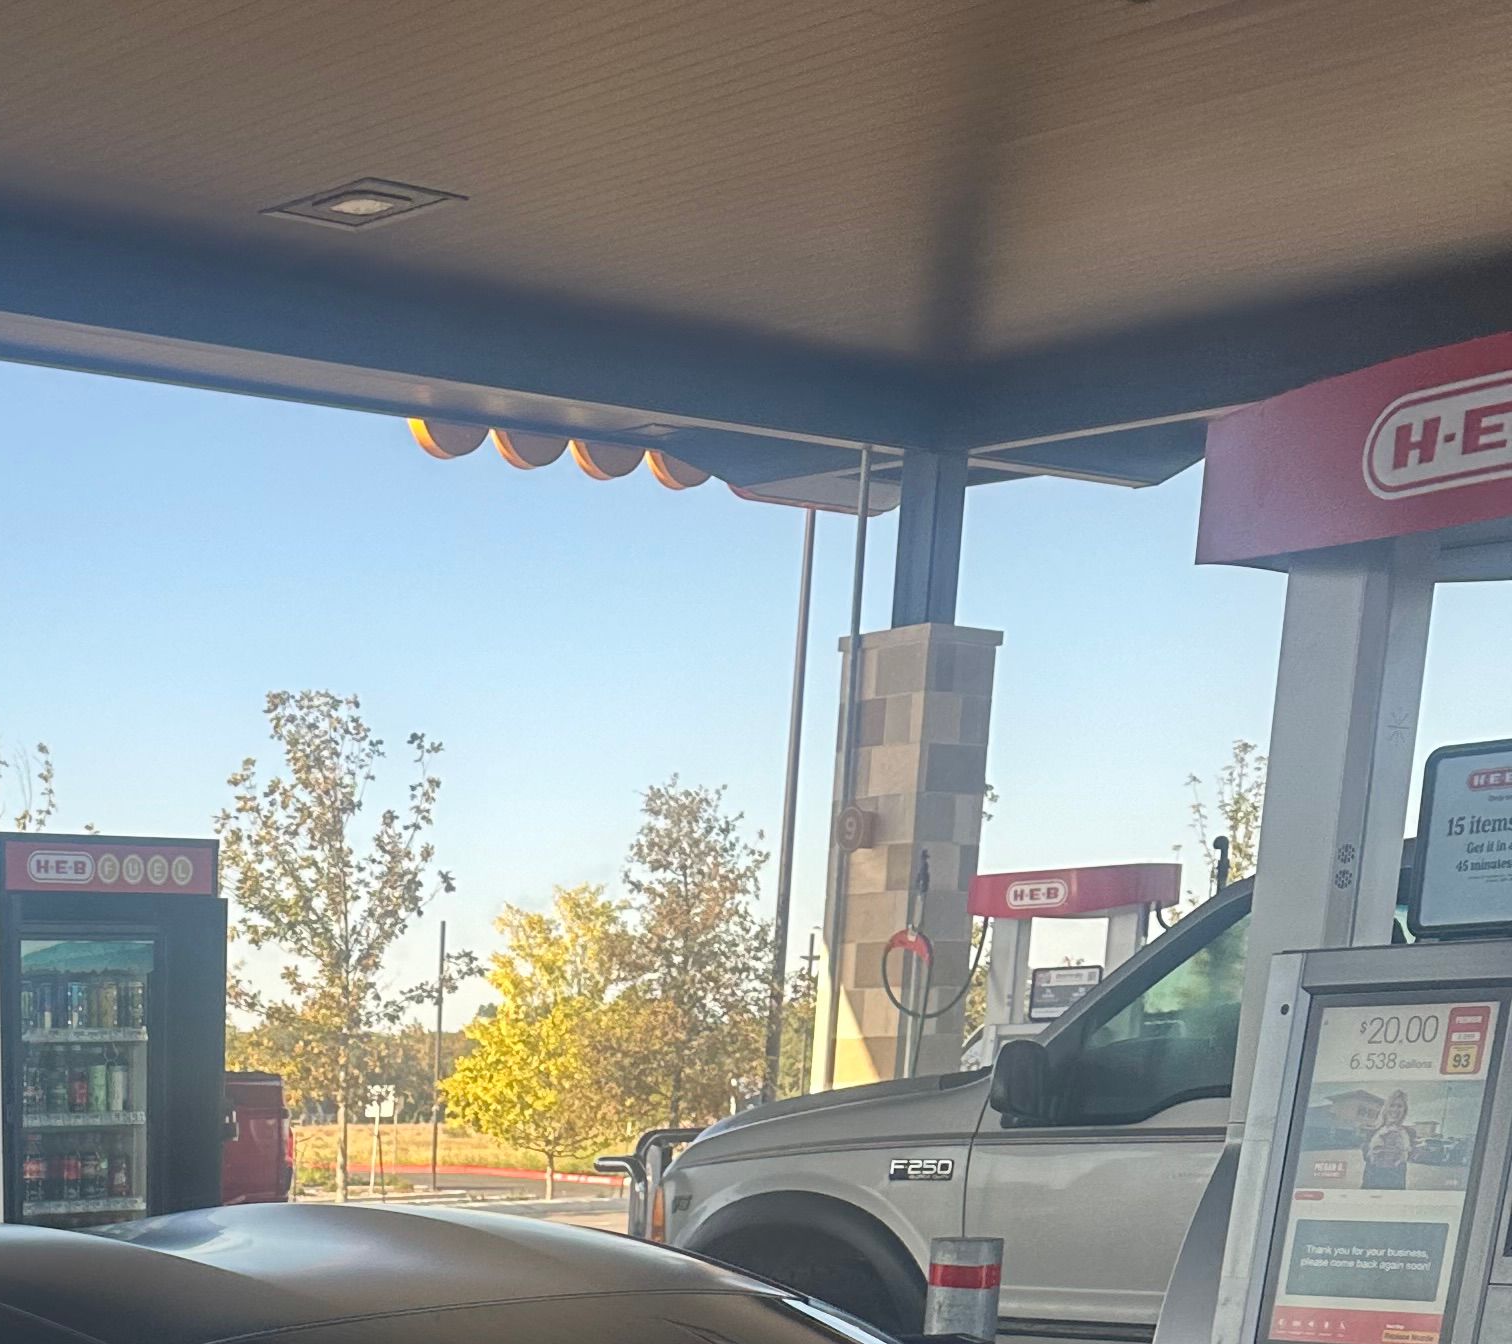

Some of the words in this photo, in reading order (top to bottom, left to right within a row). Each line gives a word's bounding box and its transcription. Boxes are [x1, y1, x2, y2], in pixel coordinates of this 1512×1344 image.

[844, 816, 857, 841] 9
[1446, 815, 1467, 837] 15
[1466, 841, 1485, 854] Get
[1487, 840, 1495, 852] it
[1496, 840, 1506, 852] in
[101, 858, 190, 880] FUEL
[1455, 859, 1469, 872] 45
[1359, 1015, 1440, 1045] $20.00
[1399, 1059, 1433, 1069] Gallons
[1452, 1053, 1472, 1069] 93
[1306, 1244, 1332, 1255] Thank
[1333, 1247, 1350, 1257] you
[1351, 1245, 1364, 1256] for
[1365, 1247, 1387, 1258] your
[1300, 1257, 1329, 1267] please
[1329, 1259, 1355, 1268] come
[1355, 1259, 1378, 1269] back
[1378, 1262, 1404, 1272] again
